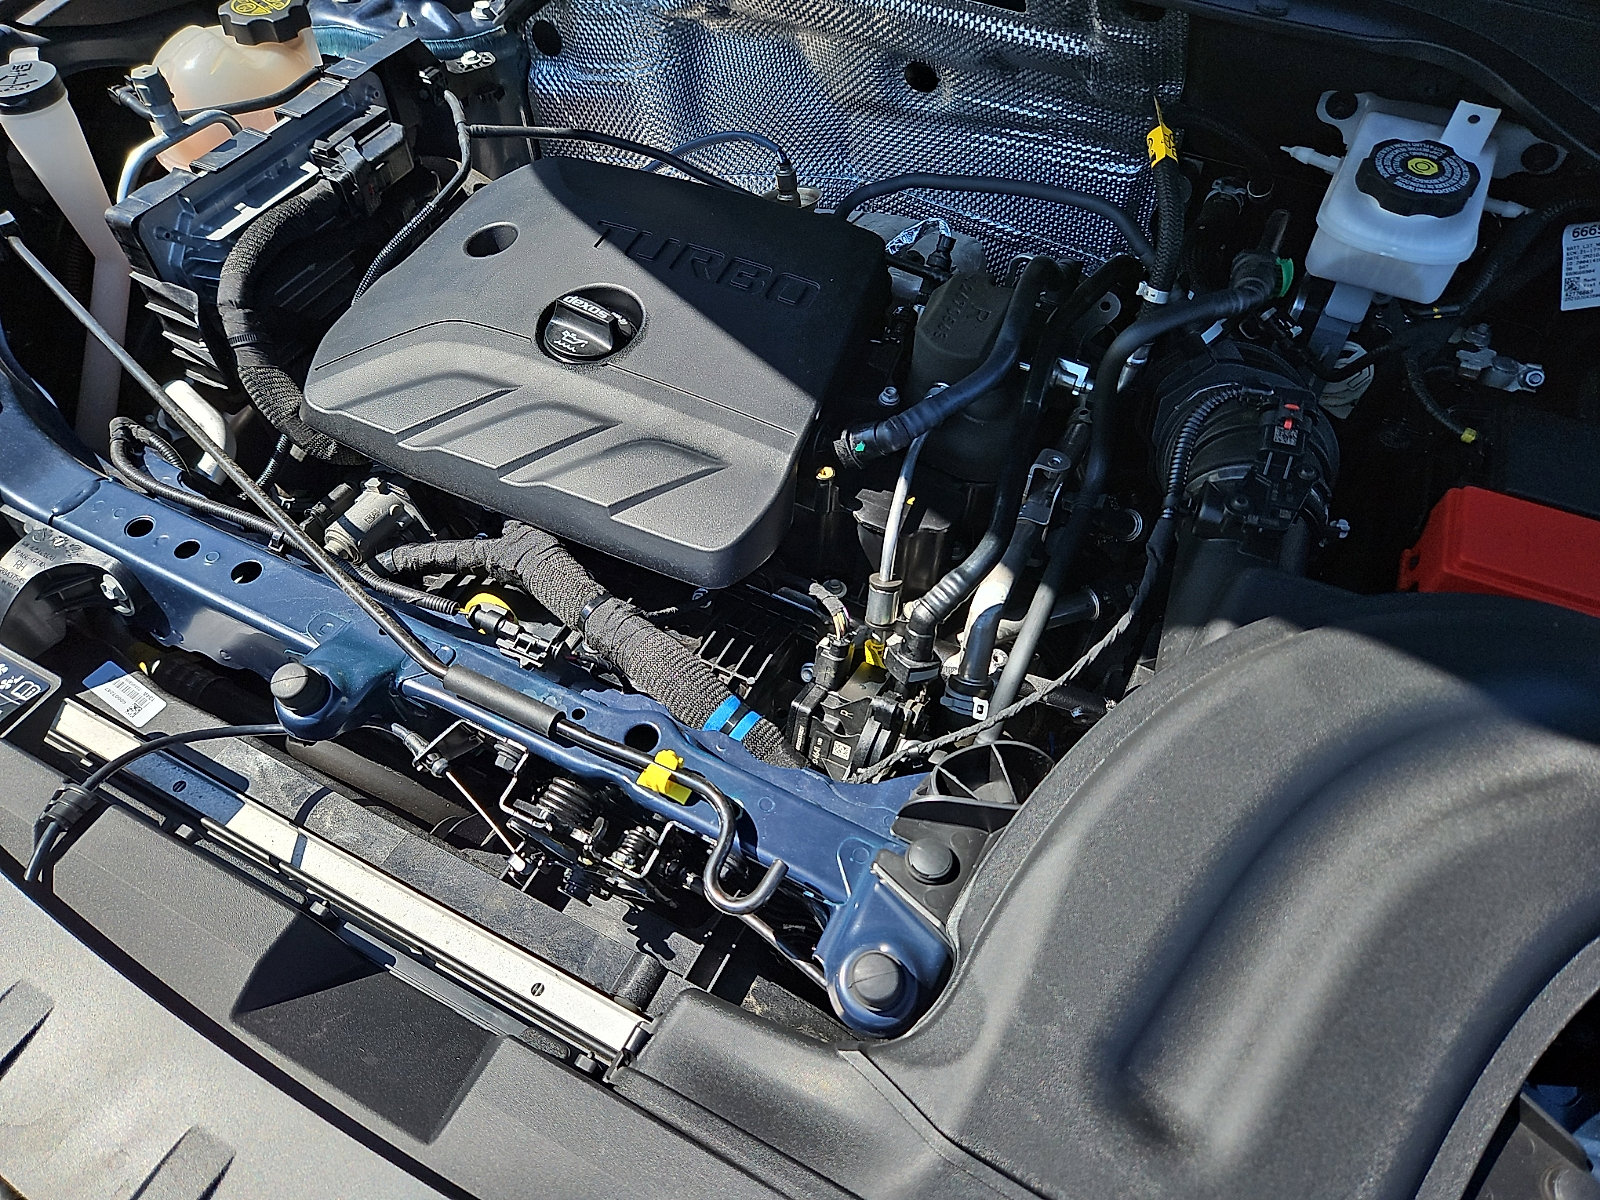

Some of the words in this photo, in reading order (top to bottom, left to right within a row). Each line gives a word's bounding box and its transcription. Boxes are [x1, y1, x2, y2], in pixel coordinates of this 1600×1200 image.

[593, 219, 820, 305] TURBO
[562, 295, 611, 319] dexos
[13, 559, 28, 571] RH
[840, 709, 854, 719] R
